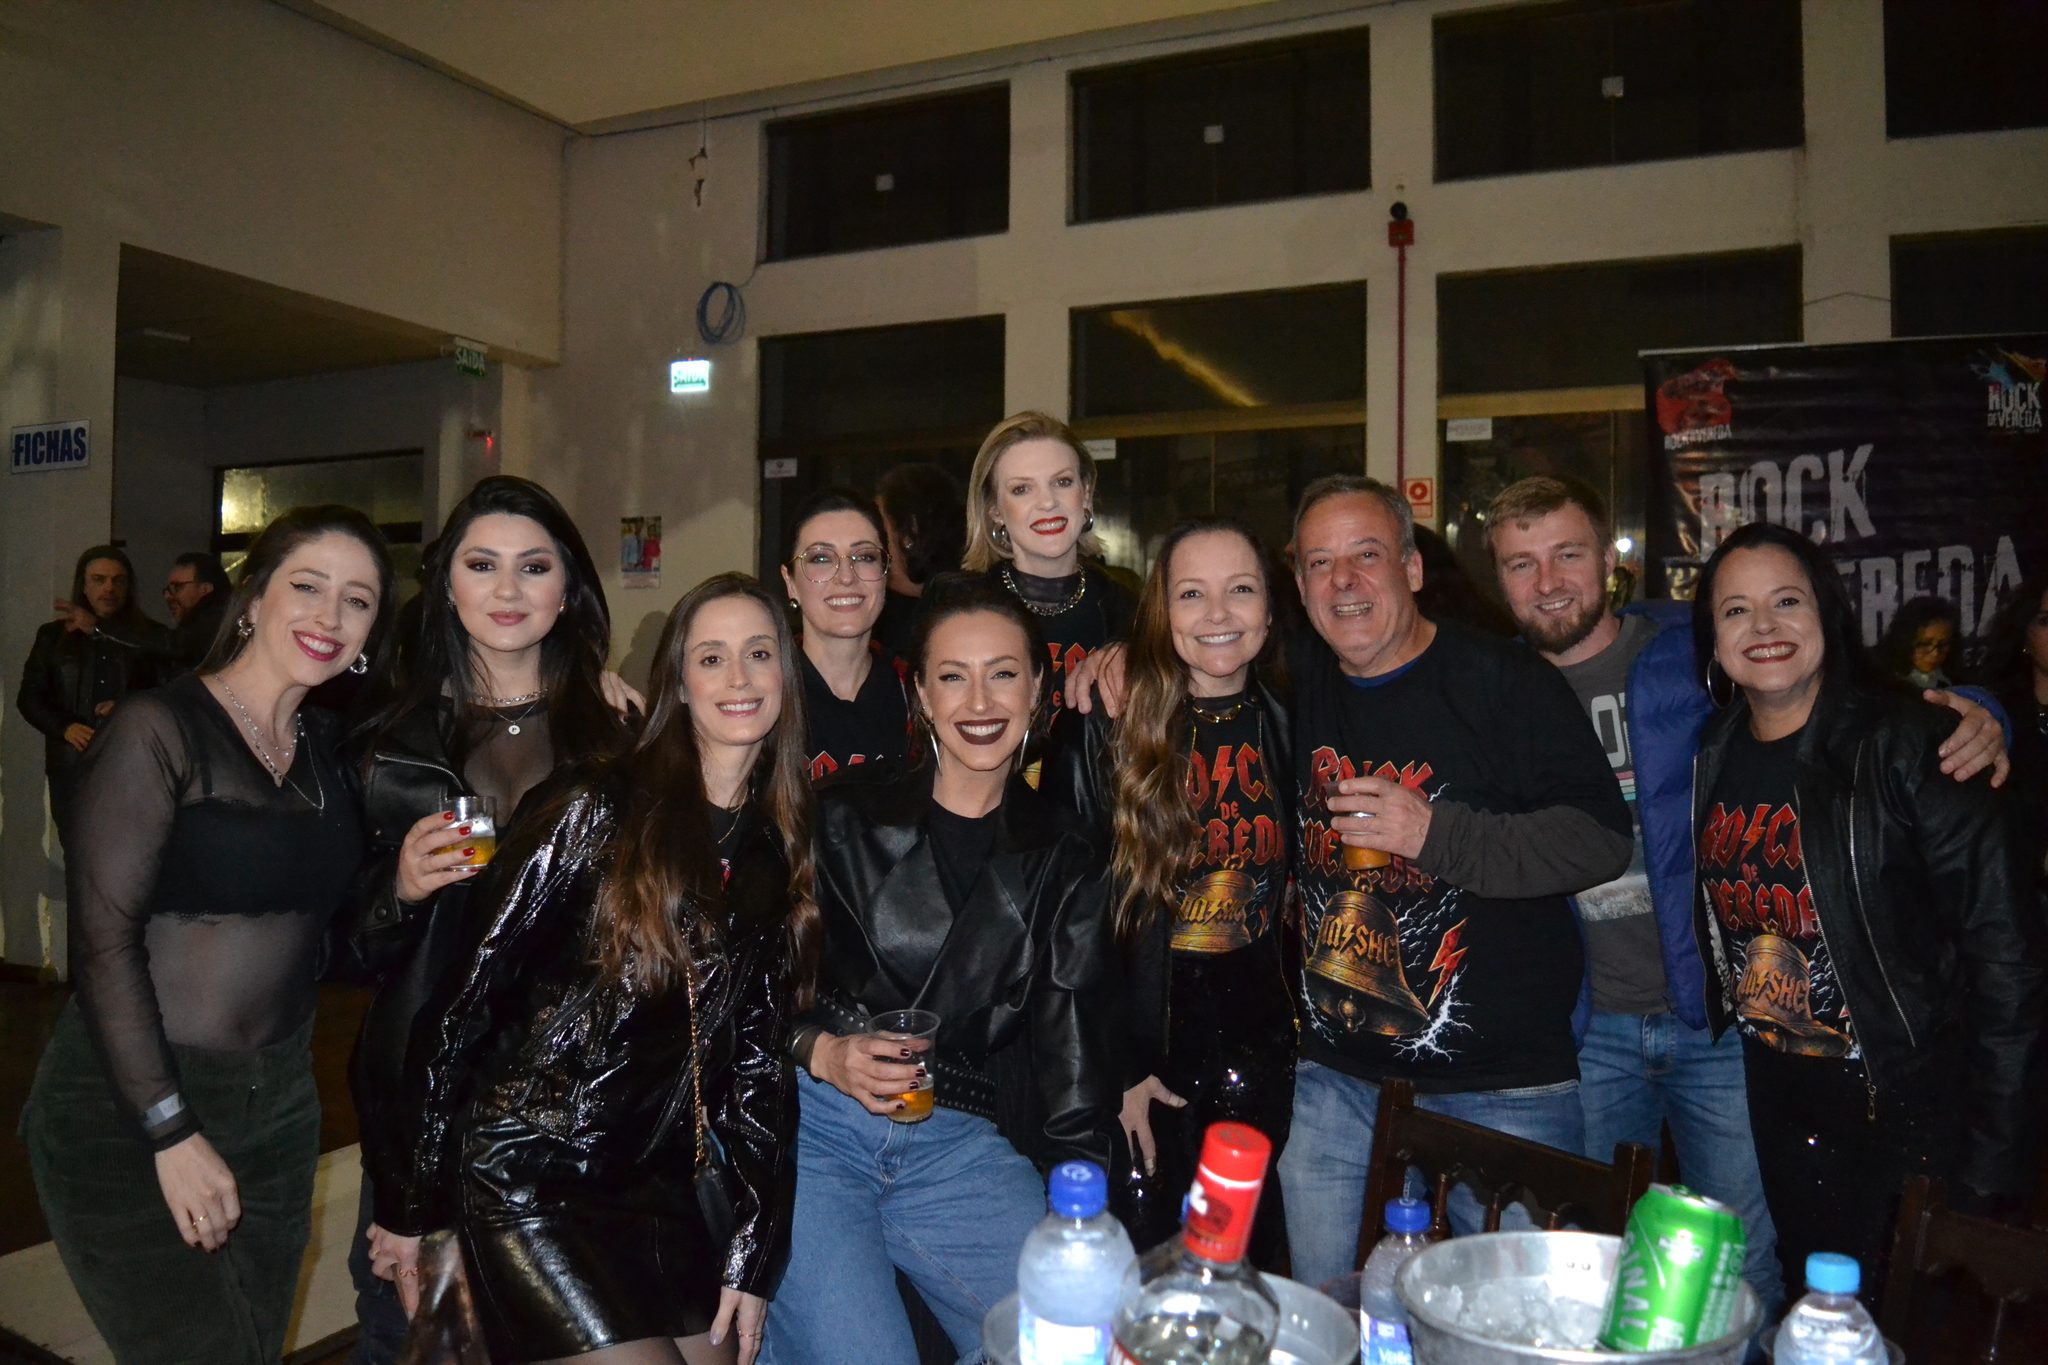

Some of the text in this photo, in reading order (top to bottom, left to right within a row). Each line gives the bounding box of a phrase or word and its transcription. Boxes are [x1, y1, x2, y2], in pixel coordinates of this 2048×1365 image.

[1988, 382, 2041, 411] ROCK
[14, 426, 87, 466] FICHAS
[1220, 801, 1240, 820] DE
